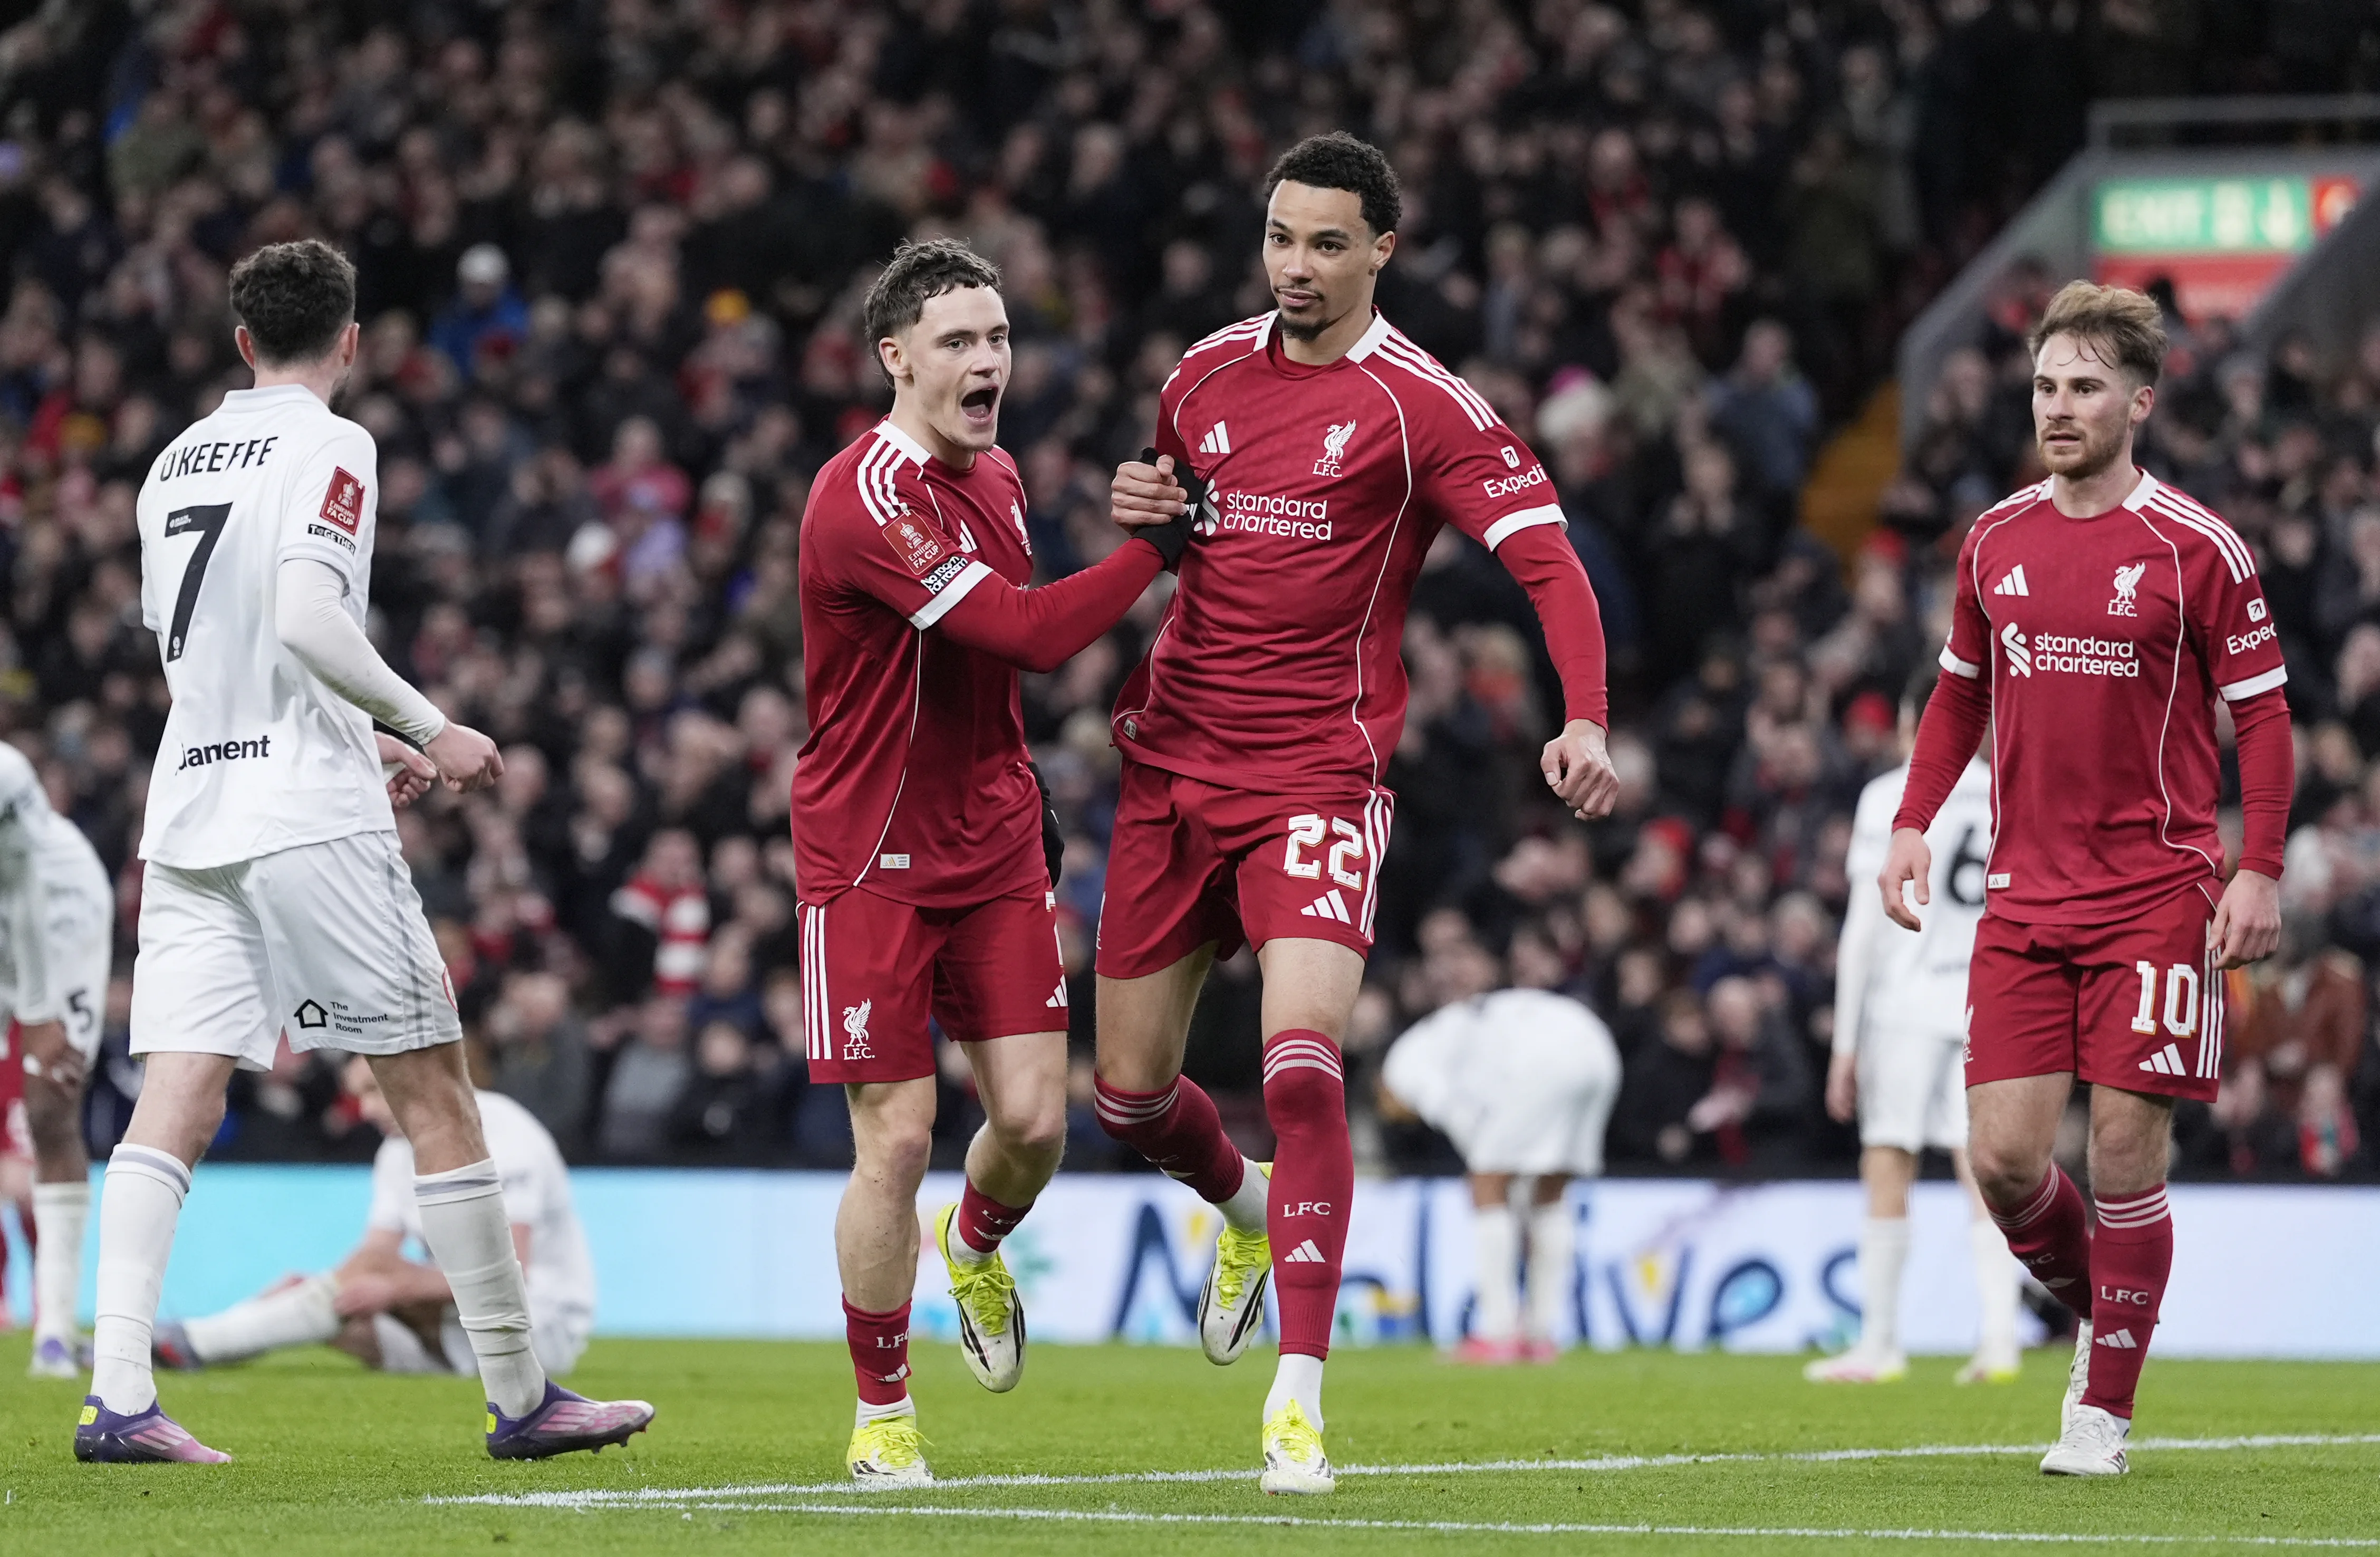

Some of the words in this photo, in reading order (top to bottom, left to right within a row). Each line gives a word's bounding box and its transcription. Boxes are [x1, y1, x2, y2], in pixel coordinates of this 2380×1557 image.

[160, 436, 278, 482] O'KEEFFE
[1482, 463, 1547, 498] Expedi
[326, 507, 338, 518] FA
[338, 513, 354, 526] CUP
[329, 499, 355, 520] Emirates
[1227, 489, 1327, 520] standard
[1223, 510, 1332, 541] chartered
[310, 525, 355, 555] TOGETHER
[908, 539, 935, 562] Emirates
[913, 559, 927, 569] FA
[924, 545, 939, 560] CUP
[165, 501, 234, 663] 7
[920, 574, 938, 589] No
[2035, 632, 2134, 658] standard
[2035, 652, 2140, 678] chartered
[1283, 813, 1364, 891] 22
[1944, 823, 1986, 907] 6
[330, 1002, 349, 1011] The
[2131, 960, 2199, 1039] 10
[333, 1012, 389, 1024] Investment
[335, 1023, 362, 1034] Room
[1283, 1202, 1331, 1218] LFC
[2101, 1285, 2148, 1305] LFC
